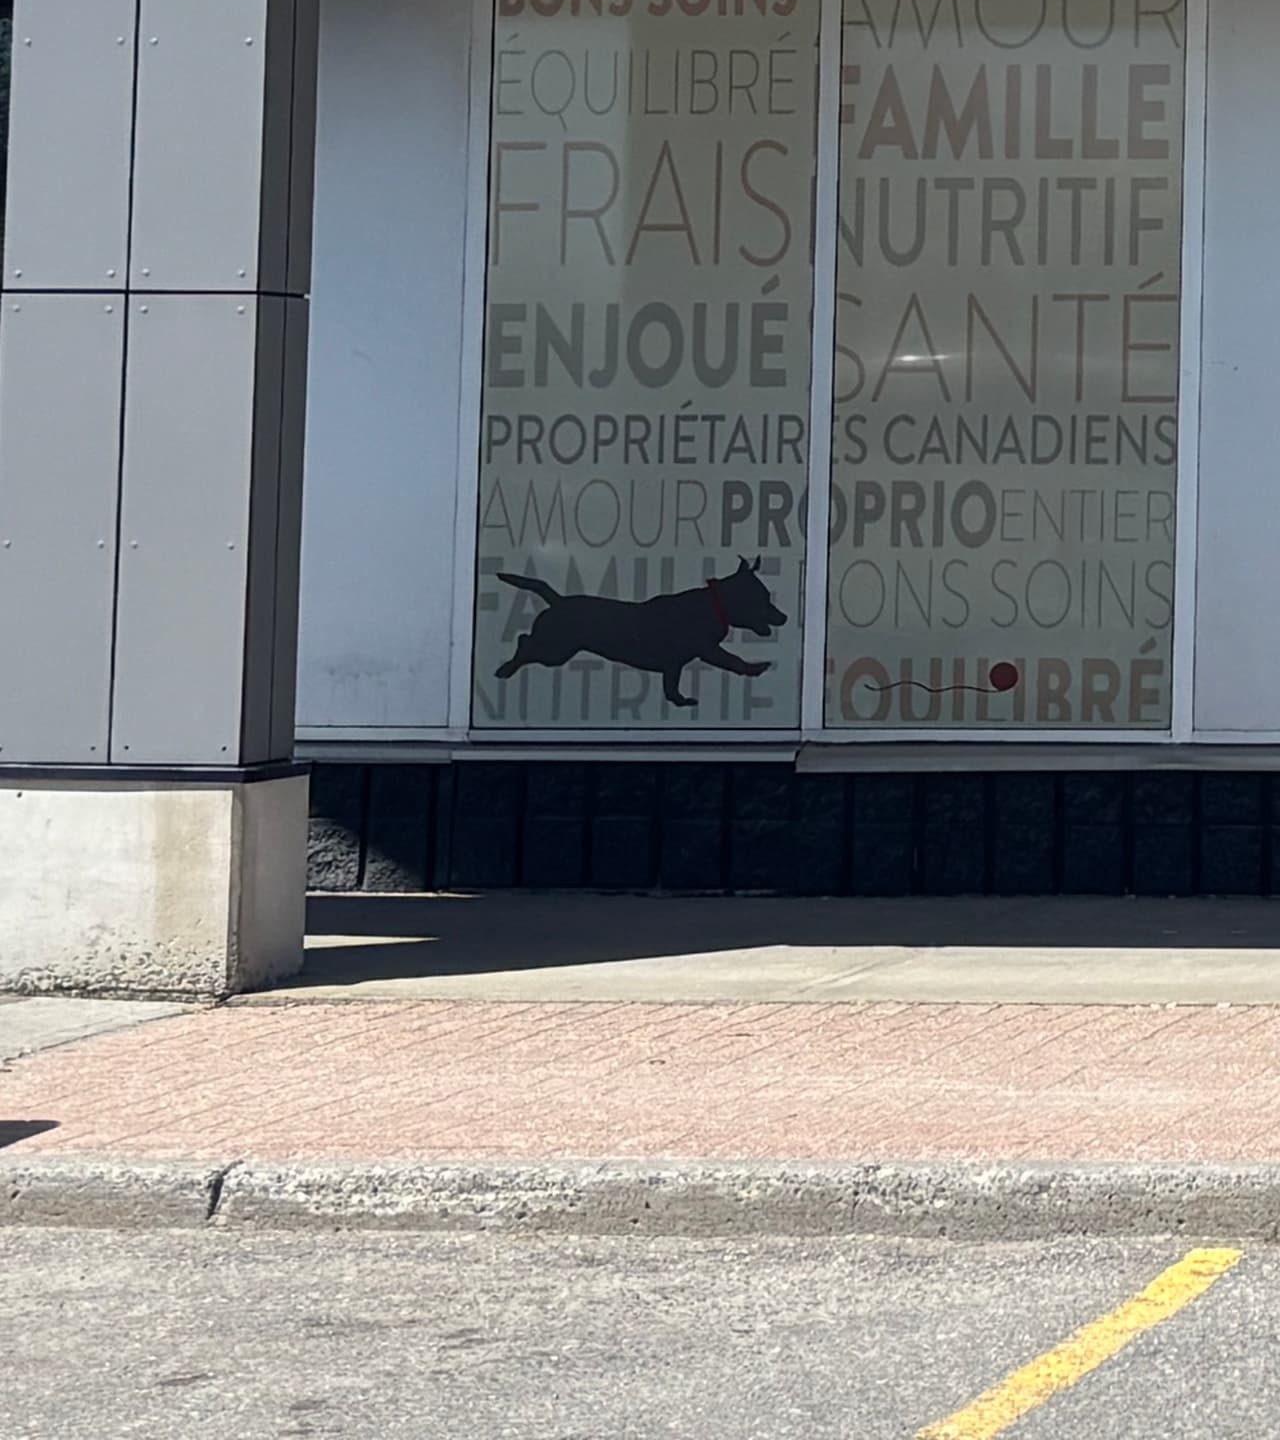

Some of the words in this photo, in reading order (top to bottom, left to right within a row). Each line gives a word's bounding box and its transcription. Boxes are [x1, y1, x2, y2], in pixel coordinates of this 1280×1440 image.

[497, 33, 797, 132] ÉQUILIBRÉ
[492, 138, 792, 267] FRAIS
[488, 274, 789, 388] ENJOUÉ
[811, 271, 1178, 403] SANTÉ
[484, 400, 868, 465] PROPRIÉTAIRS
[883, 415, 1176, 466] CANADIENS
[480, 478, 708, 549] AMOUR
[1001, 489, 1174, 544] ENTIER
[991, 559, 1172, 629] SOINS
